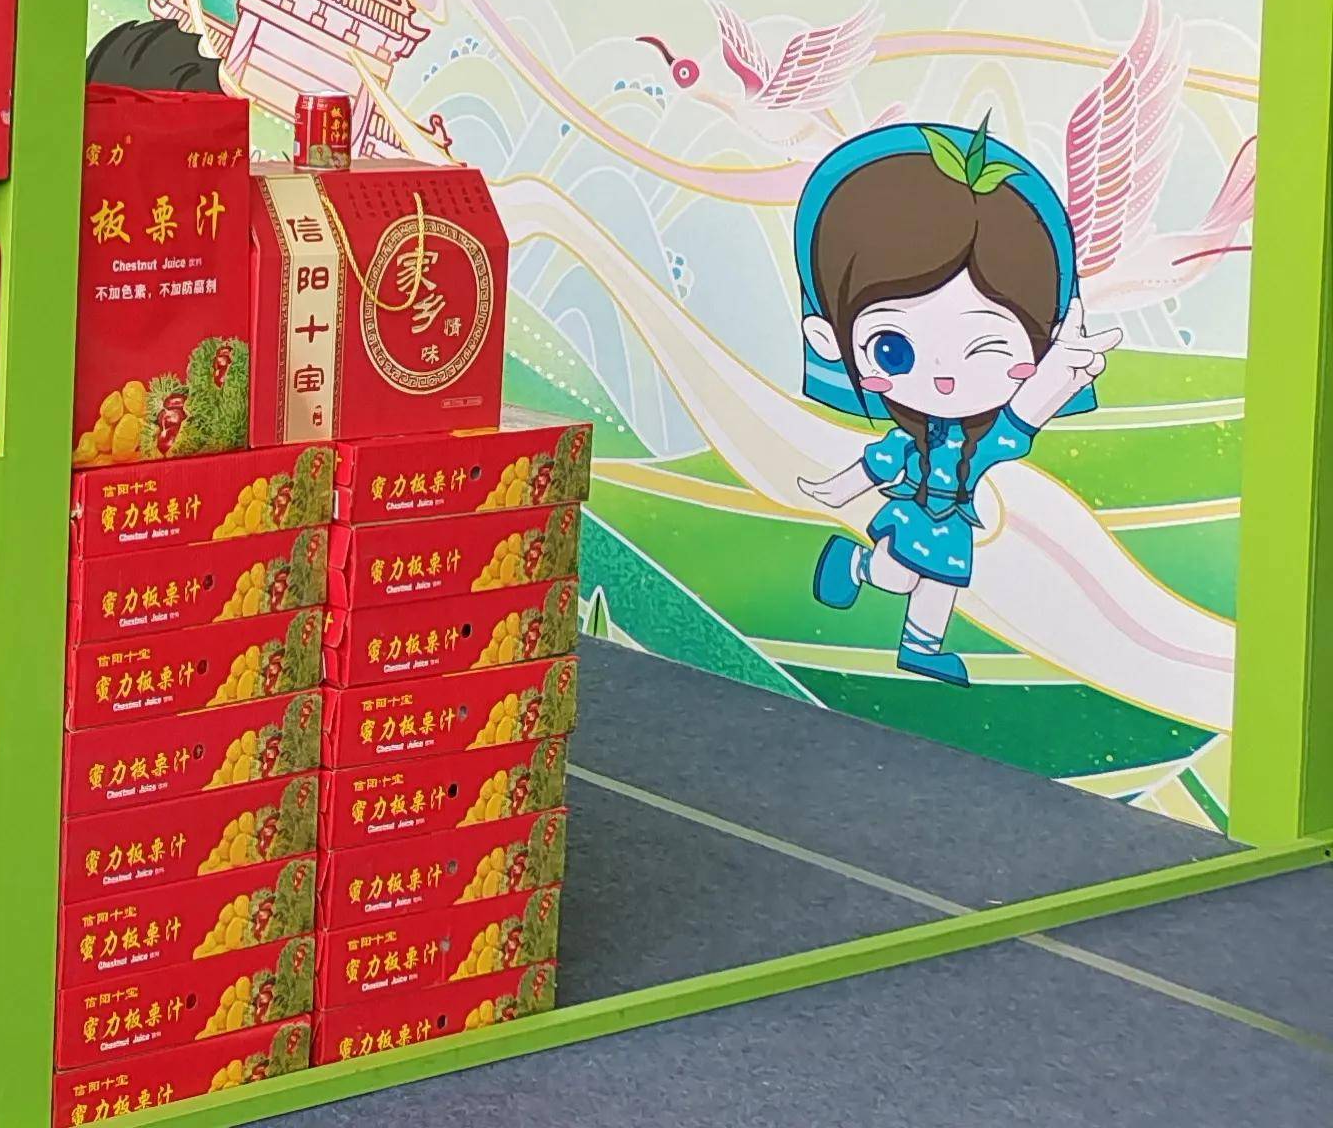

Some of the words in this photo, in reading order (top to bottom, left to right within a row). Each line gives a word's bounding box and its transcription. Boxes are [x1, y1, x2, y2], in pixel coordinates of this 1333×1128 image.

[90, 191, 226, 245] 板栗汁
[112, 258, 157, 273] Chestnut
[162, 257, 186, 269] Juice
